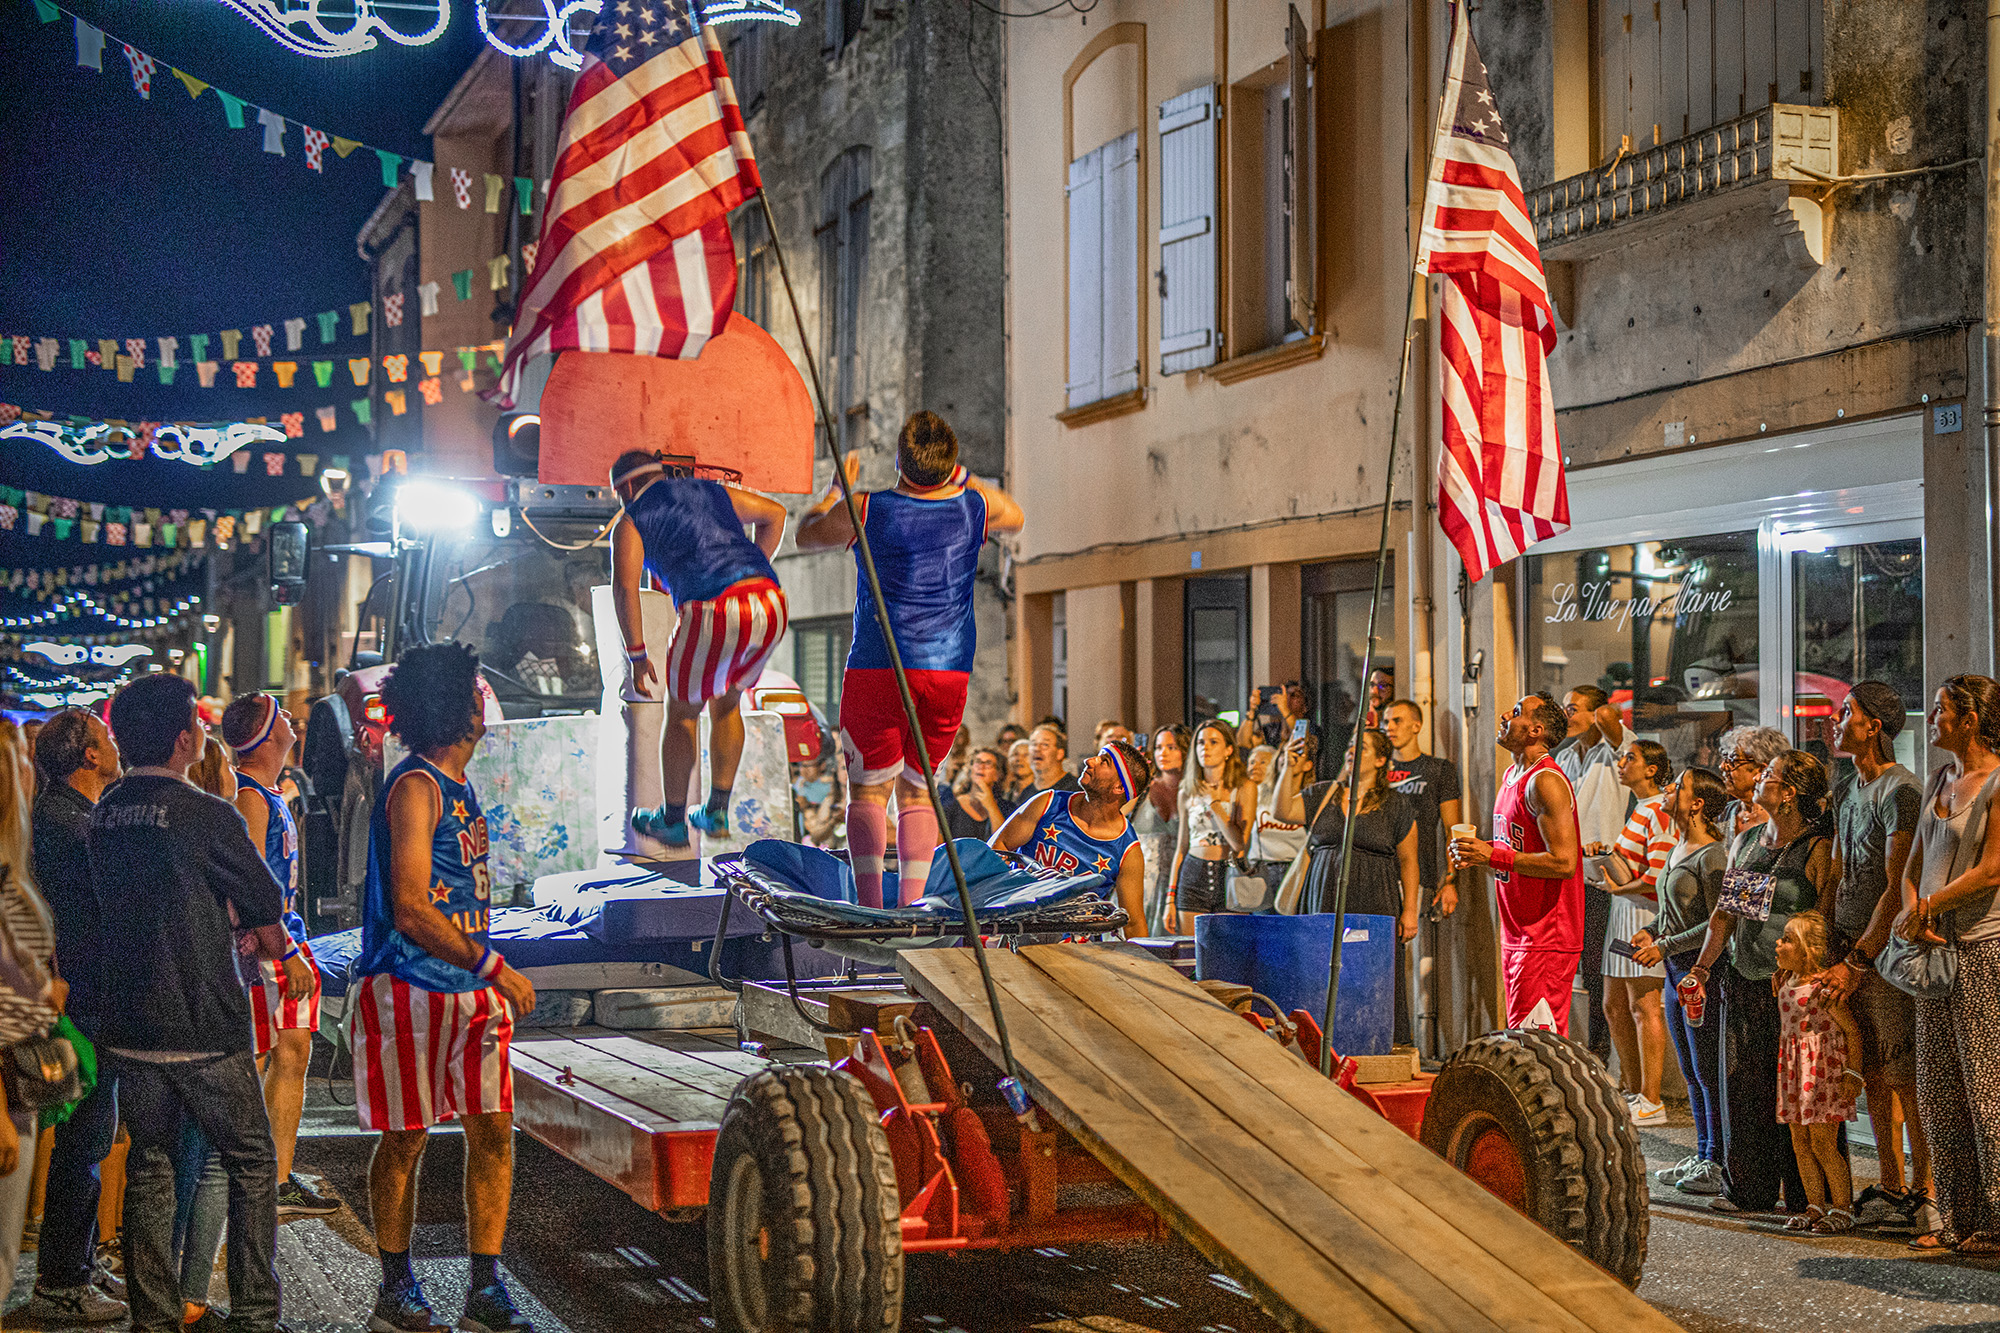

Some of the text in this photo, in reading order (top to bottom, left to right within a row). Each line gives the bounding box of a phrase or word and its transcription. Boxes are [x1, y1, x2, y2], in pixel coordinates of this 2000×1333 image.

[1940, 411, 1956, 427] 53
[1545, 573, 1732, 632] La Vue par Marie
[456, 816, 489, 867] NB
[1034, 841, 1093, 878] NB
